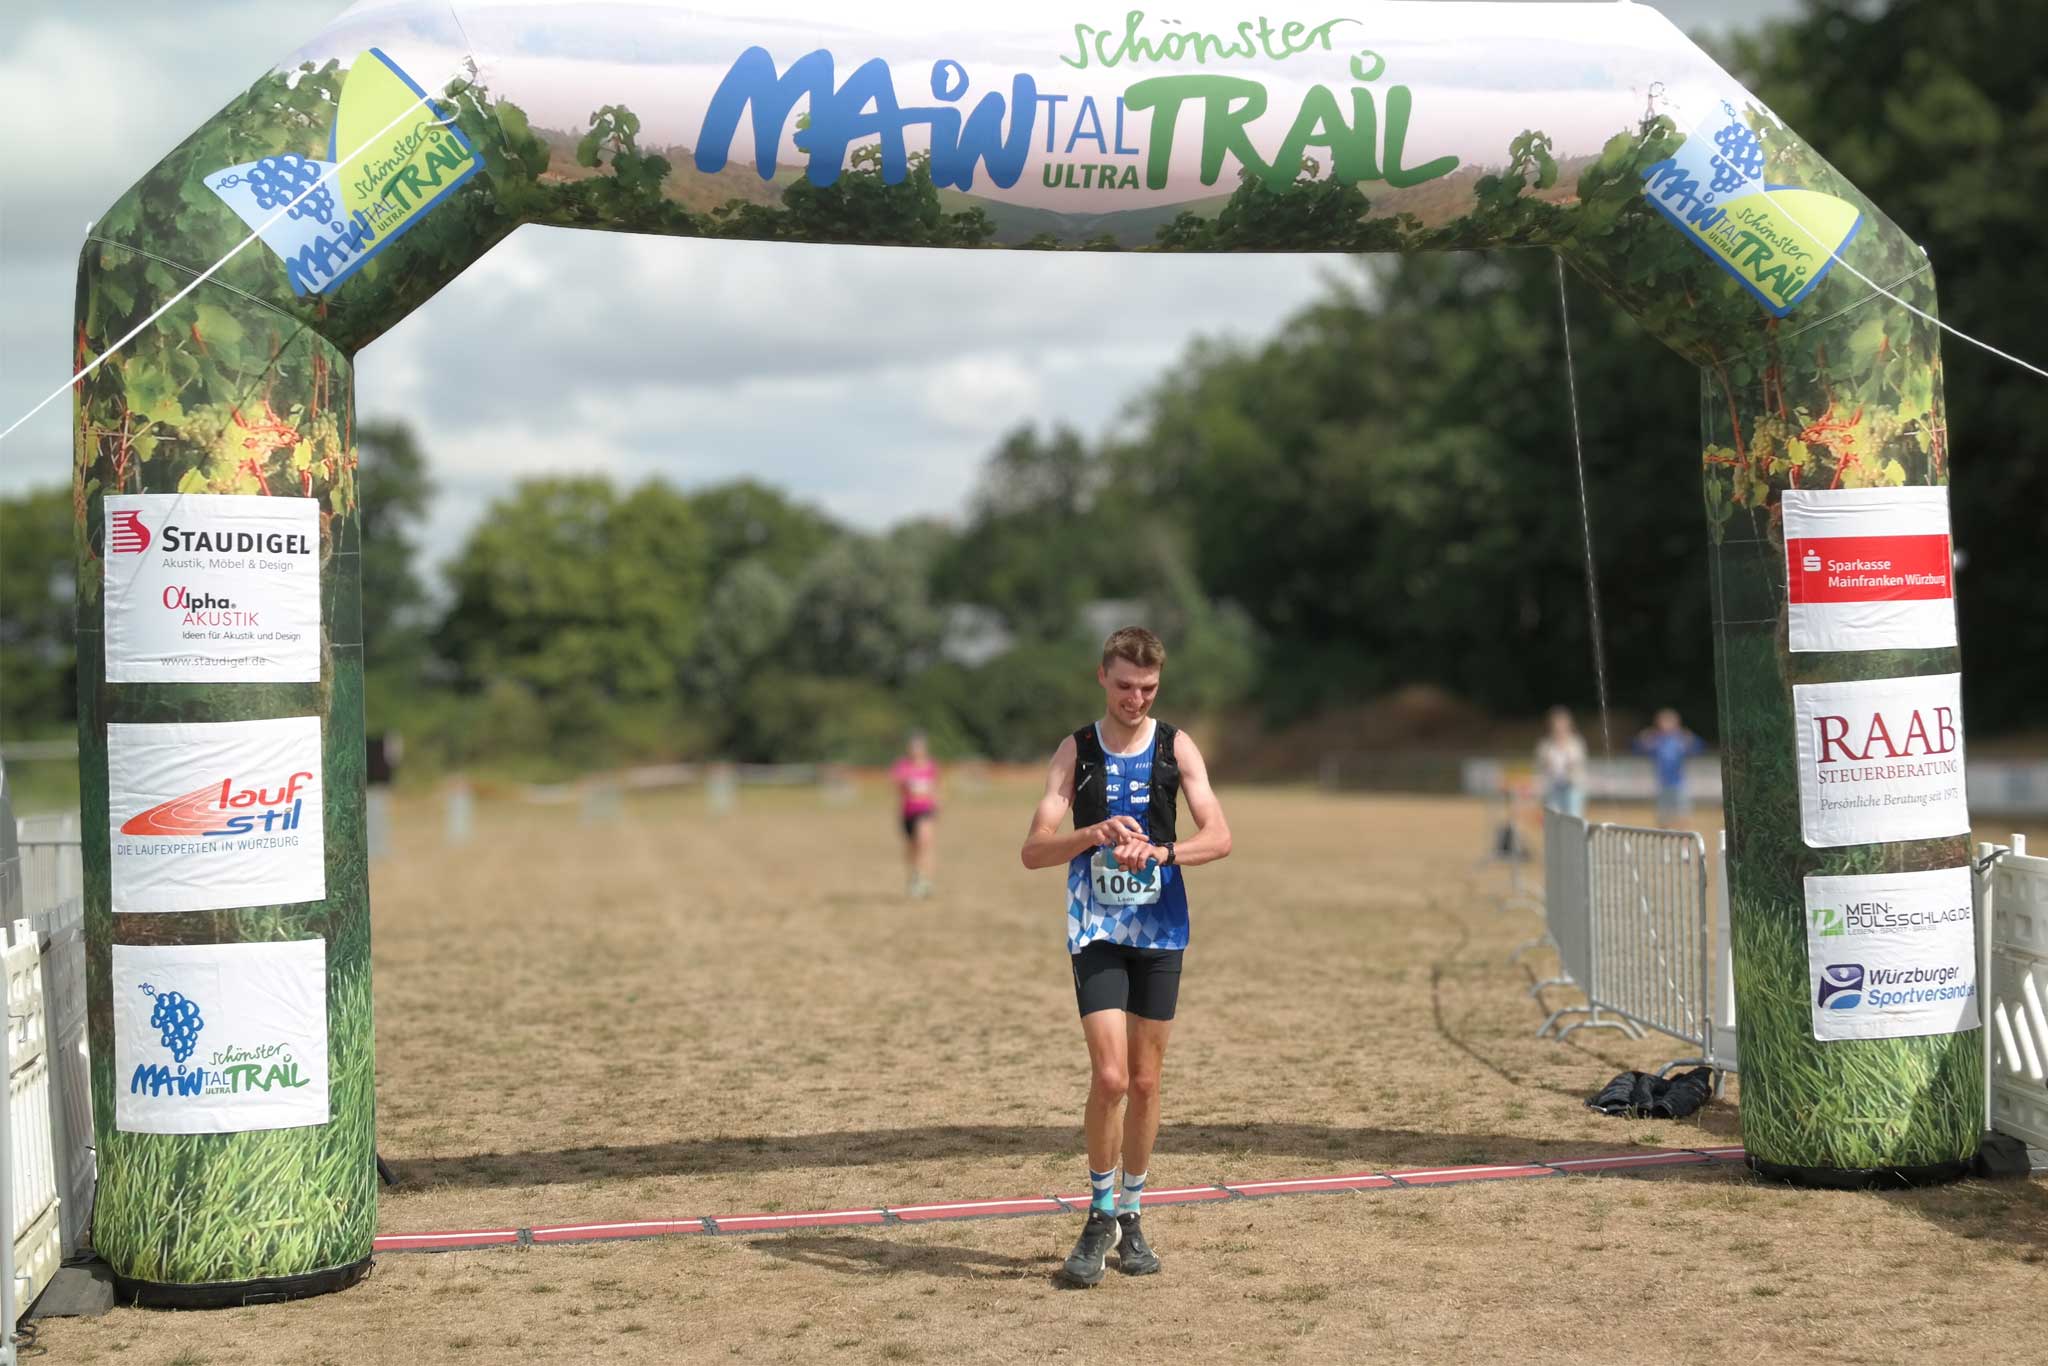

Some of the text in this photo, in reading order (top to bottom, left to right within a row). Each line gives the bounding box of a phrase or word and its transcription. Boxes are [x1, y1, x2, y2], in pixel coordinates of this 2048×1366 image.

[1060, 9, 1363, 70] schönster
[354, 121, 428, 200] schönster
[1042, 162, 1141, 190] ULTRA
[377, 207, 406, 232] ULTRA
[1708, 231, 1734, 256] ULTRA
[1736, 207, 1813, 262] schönster
[162, 525, 311, 555] STAUDIGEL
[162, 558, 294, 572] Akustik, Möbel & Design
[1827, 559, 1892, 573] Sparkasse
[1828, 573, 1946, 588] Mainfranken Würzburg
[182, 611, 259, 626] AKUSTIK
[182, 631, 301, 642] Ideen für Akustik und Design
[160, 655, 266, 669] www.staudigel.de
[1813, 706, 1956, 764] RAAB
[219, 771, 313, 809] lauf
[1820, 794, 1881, 812] Persönliche
[1884, 791, 1928, 807] Beratung
[201, 798, 302, 837] stil
[117, 844, 133, 856] DIE
[135, 841, 217, 856] LAUFEXPERTEN
[221, 841, 233, 851] IN
[1096, 874, 1157, 894] 1062
[1845, 902, 1894, 916] MEIN-
[1868, 966, 1960, 985] Würzburger
[209, 1041, 289, 1066] schönster
[205, 1087, 231, 1095] ULTRA
